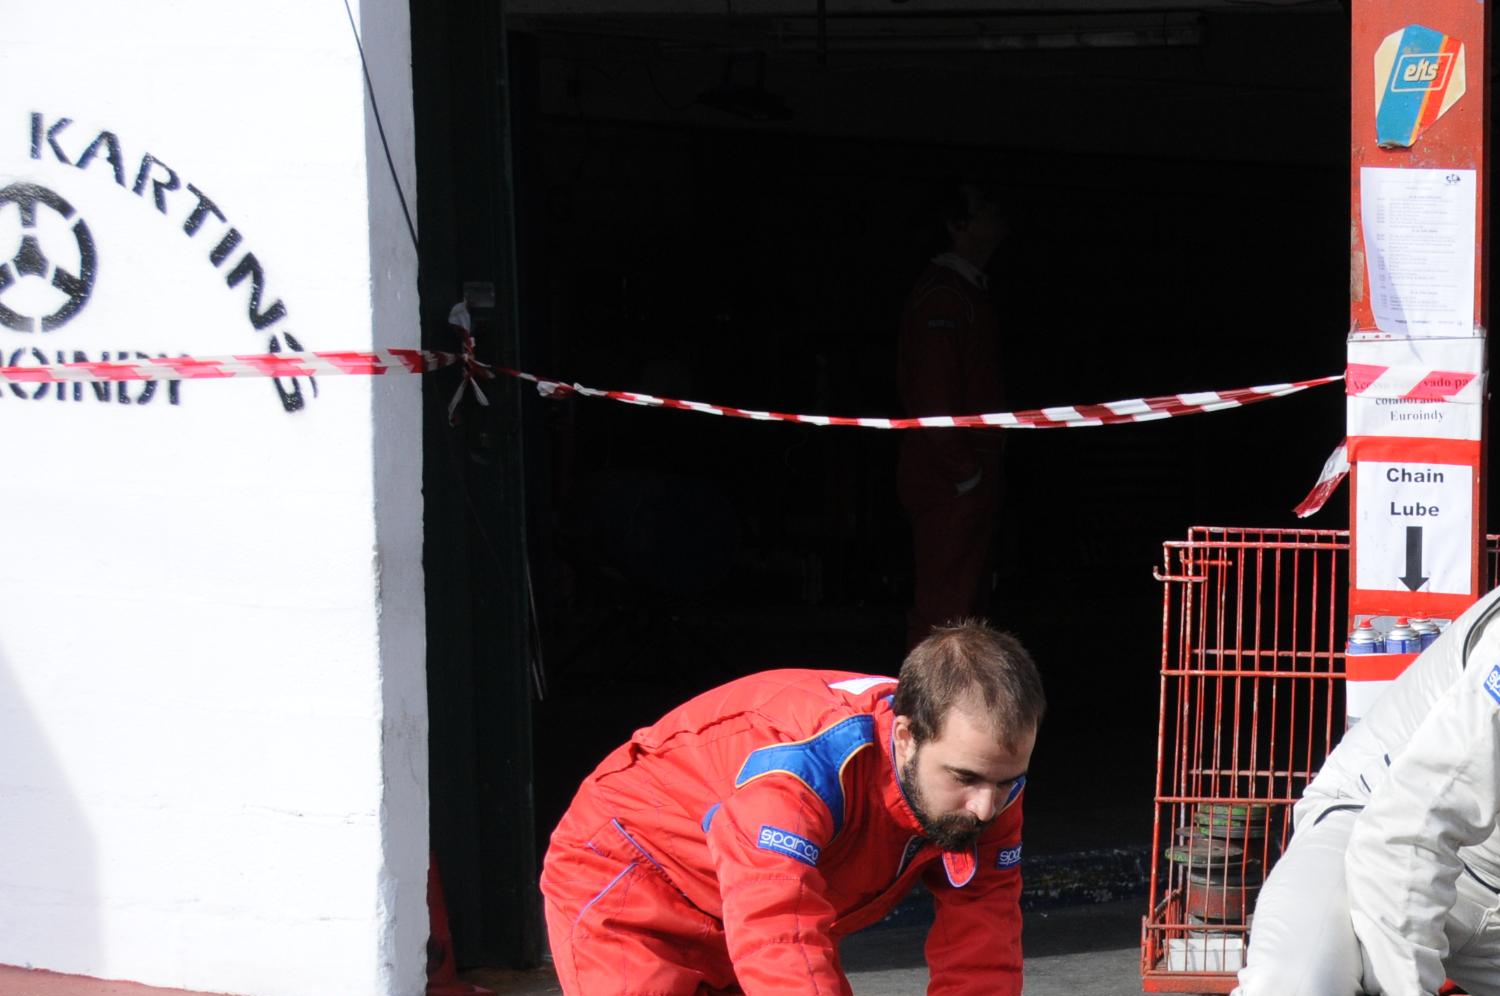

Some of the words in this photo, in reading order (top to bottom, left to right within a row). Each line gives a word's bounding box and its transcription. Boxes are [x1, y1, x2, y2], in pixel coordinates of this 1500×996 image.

[30, 111, 319, 413] KARTING
[1390, 409, 1445, 422] Euroindy
[1385, 467, 1445, 484] Chain
[1389, 501, 1441, 517] Lube
[759, 828, 819, 862] sparco
